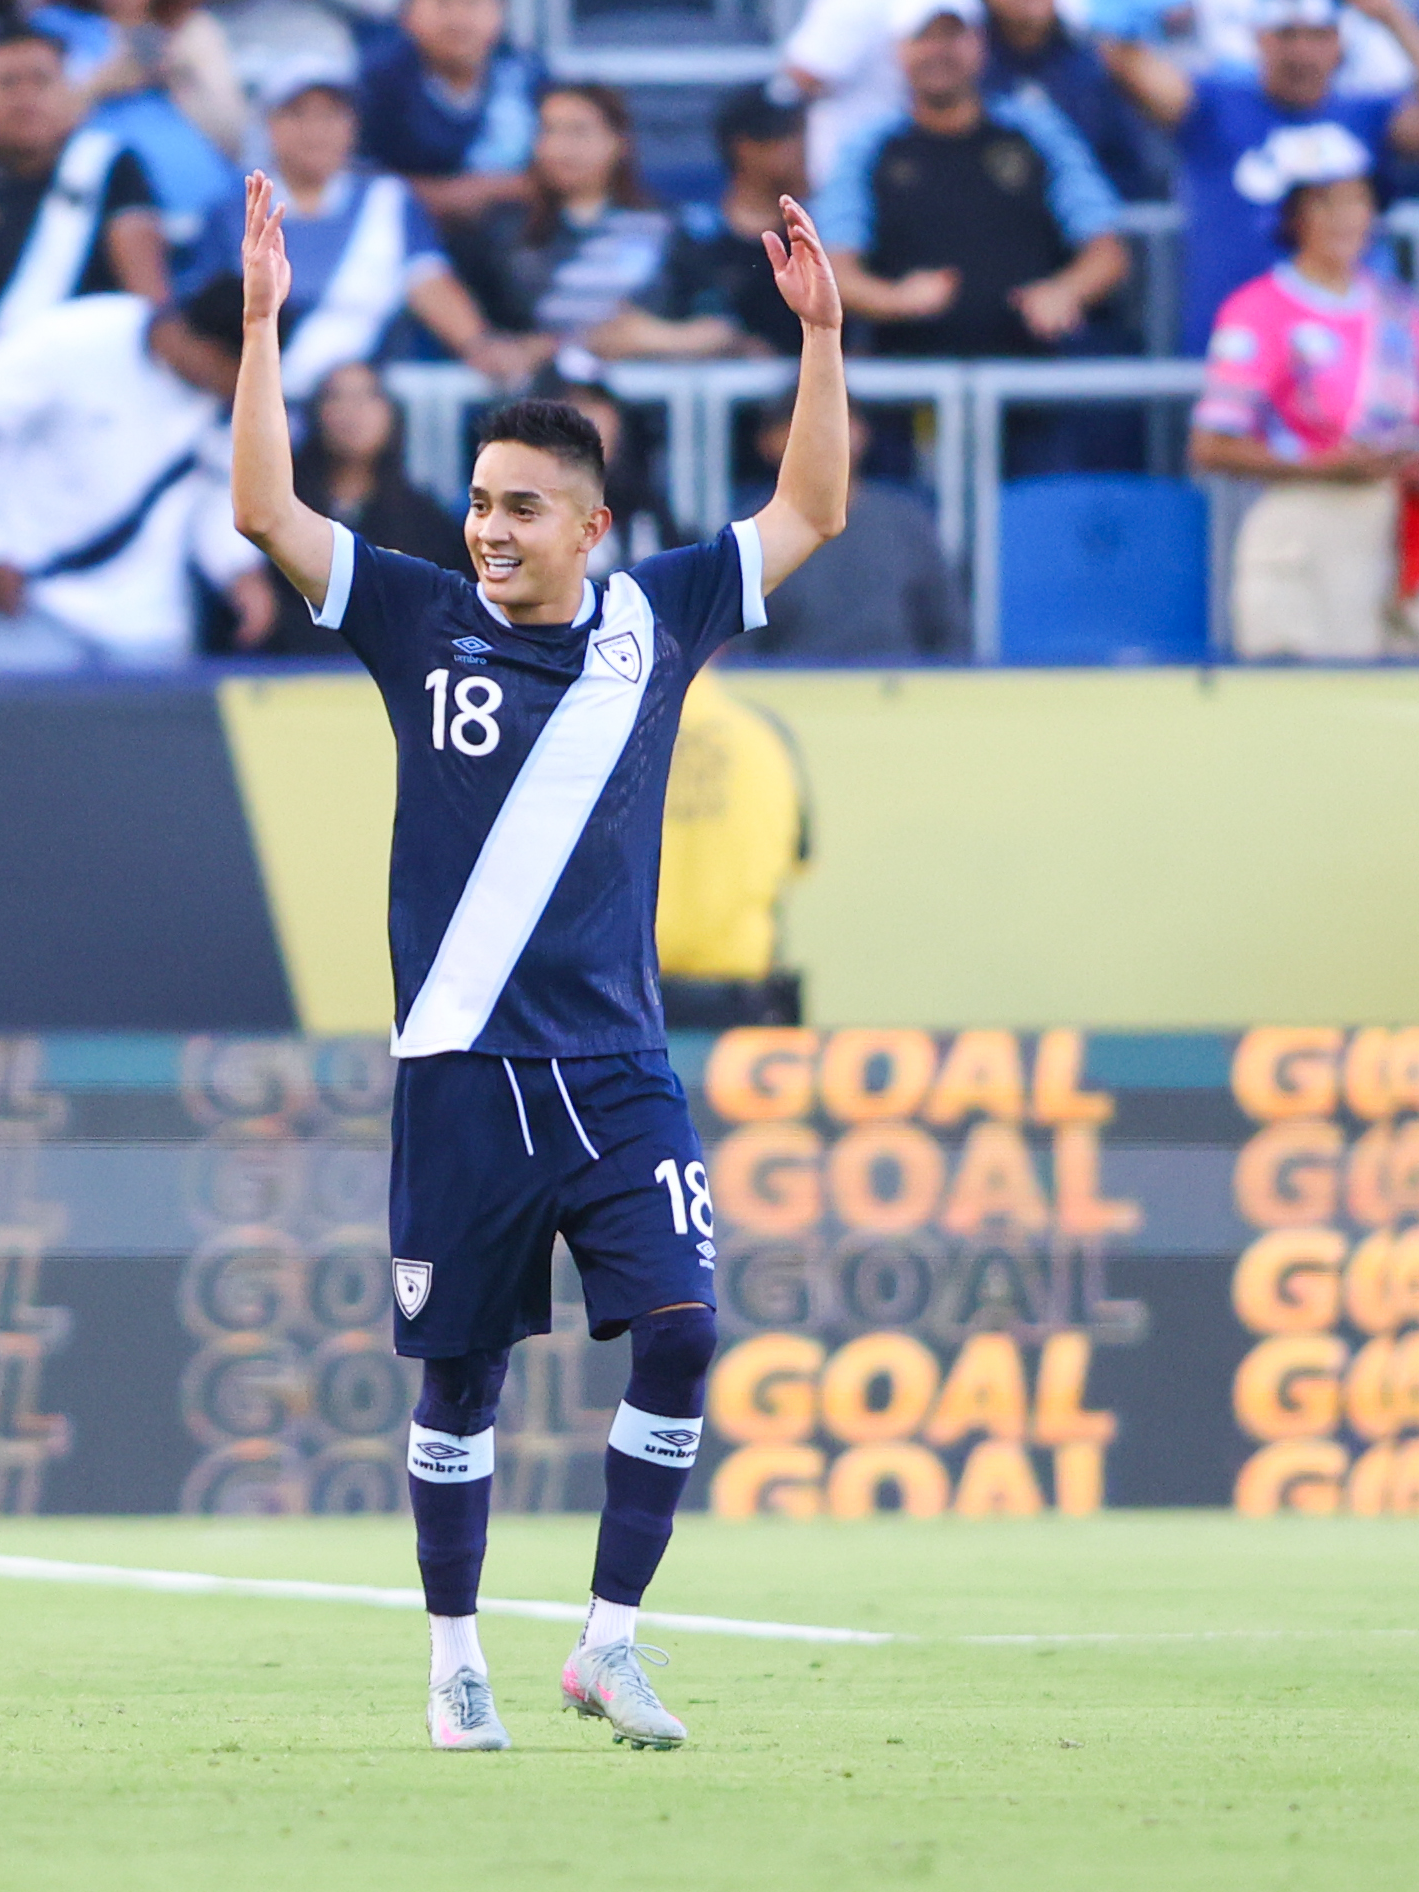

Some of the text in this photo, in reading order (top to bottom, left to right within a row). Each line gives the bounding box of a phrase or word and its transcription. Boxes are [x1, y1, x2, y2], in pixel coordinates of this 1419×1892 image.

[425, 668, 503, 757] 18
[703, 1024, 1116, 1126] GOAL
[654, 1159, 714, 1239] 18
[711, 1119, 1142, 1238] GOAL
[708, 1331, 1117, 1446] GOAL
